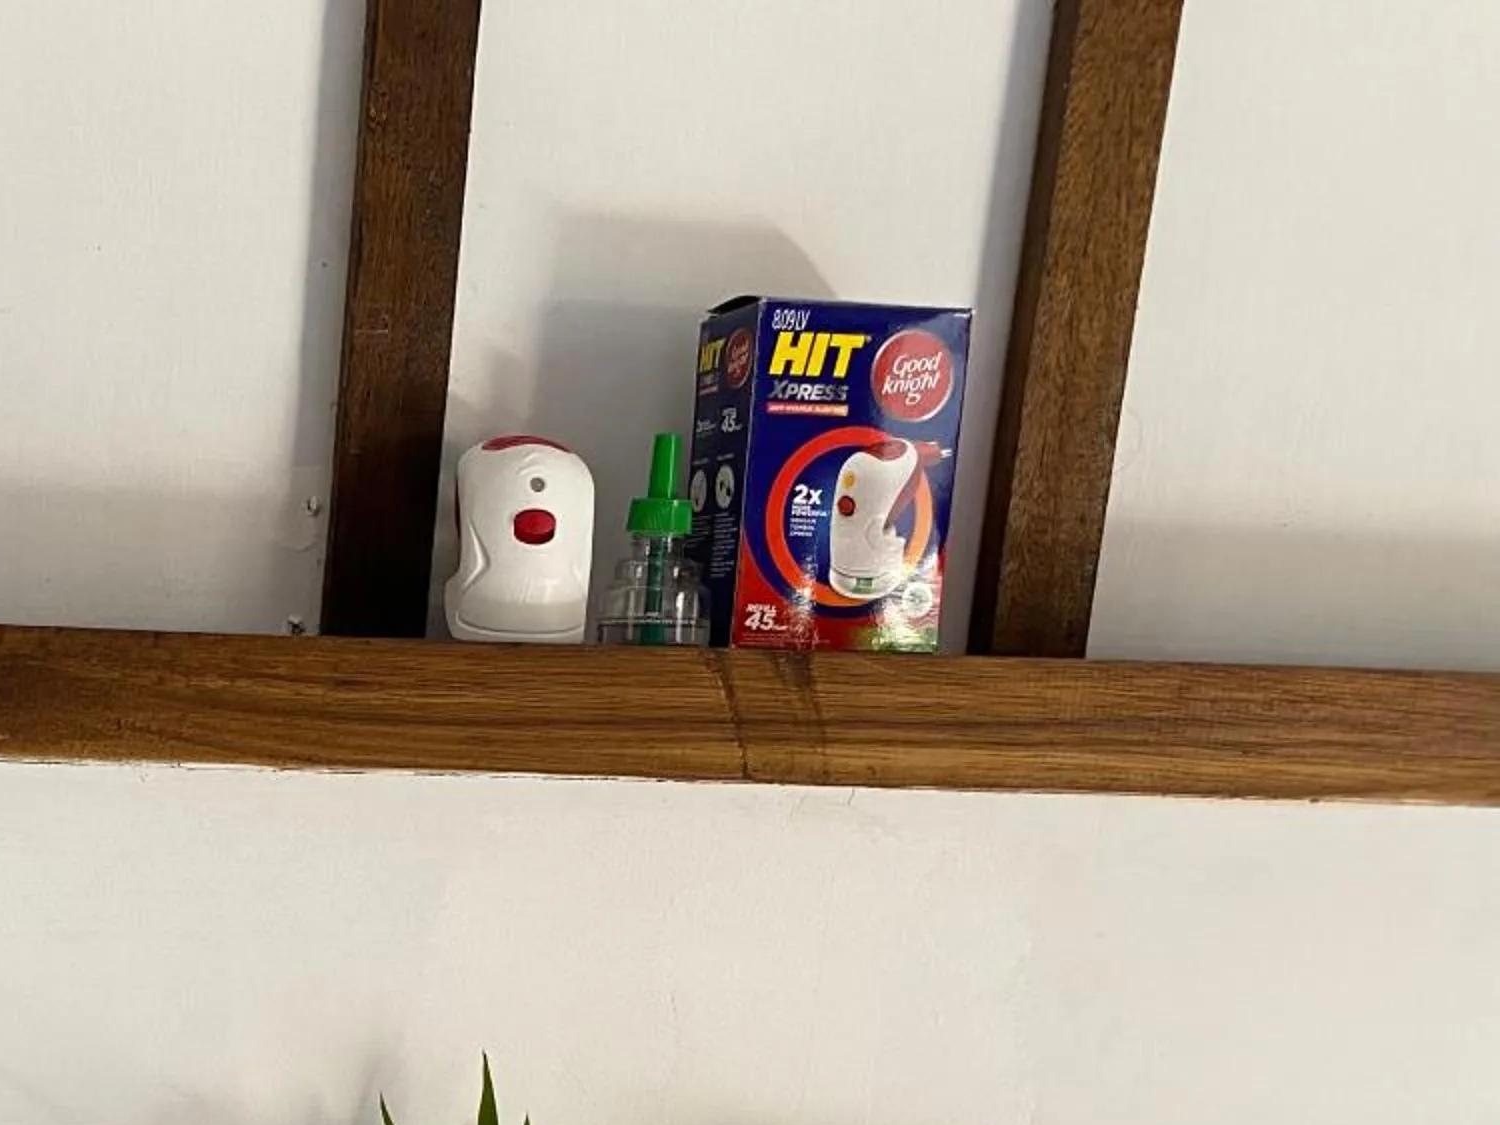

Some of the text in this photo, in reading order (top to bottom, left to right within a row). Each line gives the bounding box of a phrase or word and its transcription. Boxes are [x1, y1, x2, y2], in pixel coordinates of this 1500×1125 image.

[768, 331, 865, 378] HIT
[892, 351, 940, 376] Good
[767, 380, 849, 401] XPRESS
[881, 371, 941, 405] knight
[744, 611, 776, 631] 45
